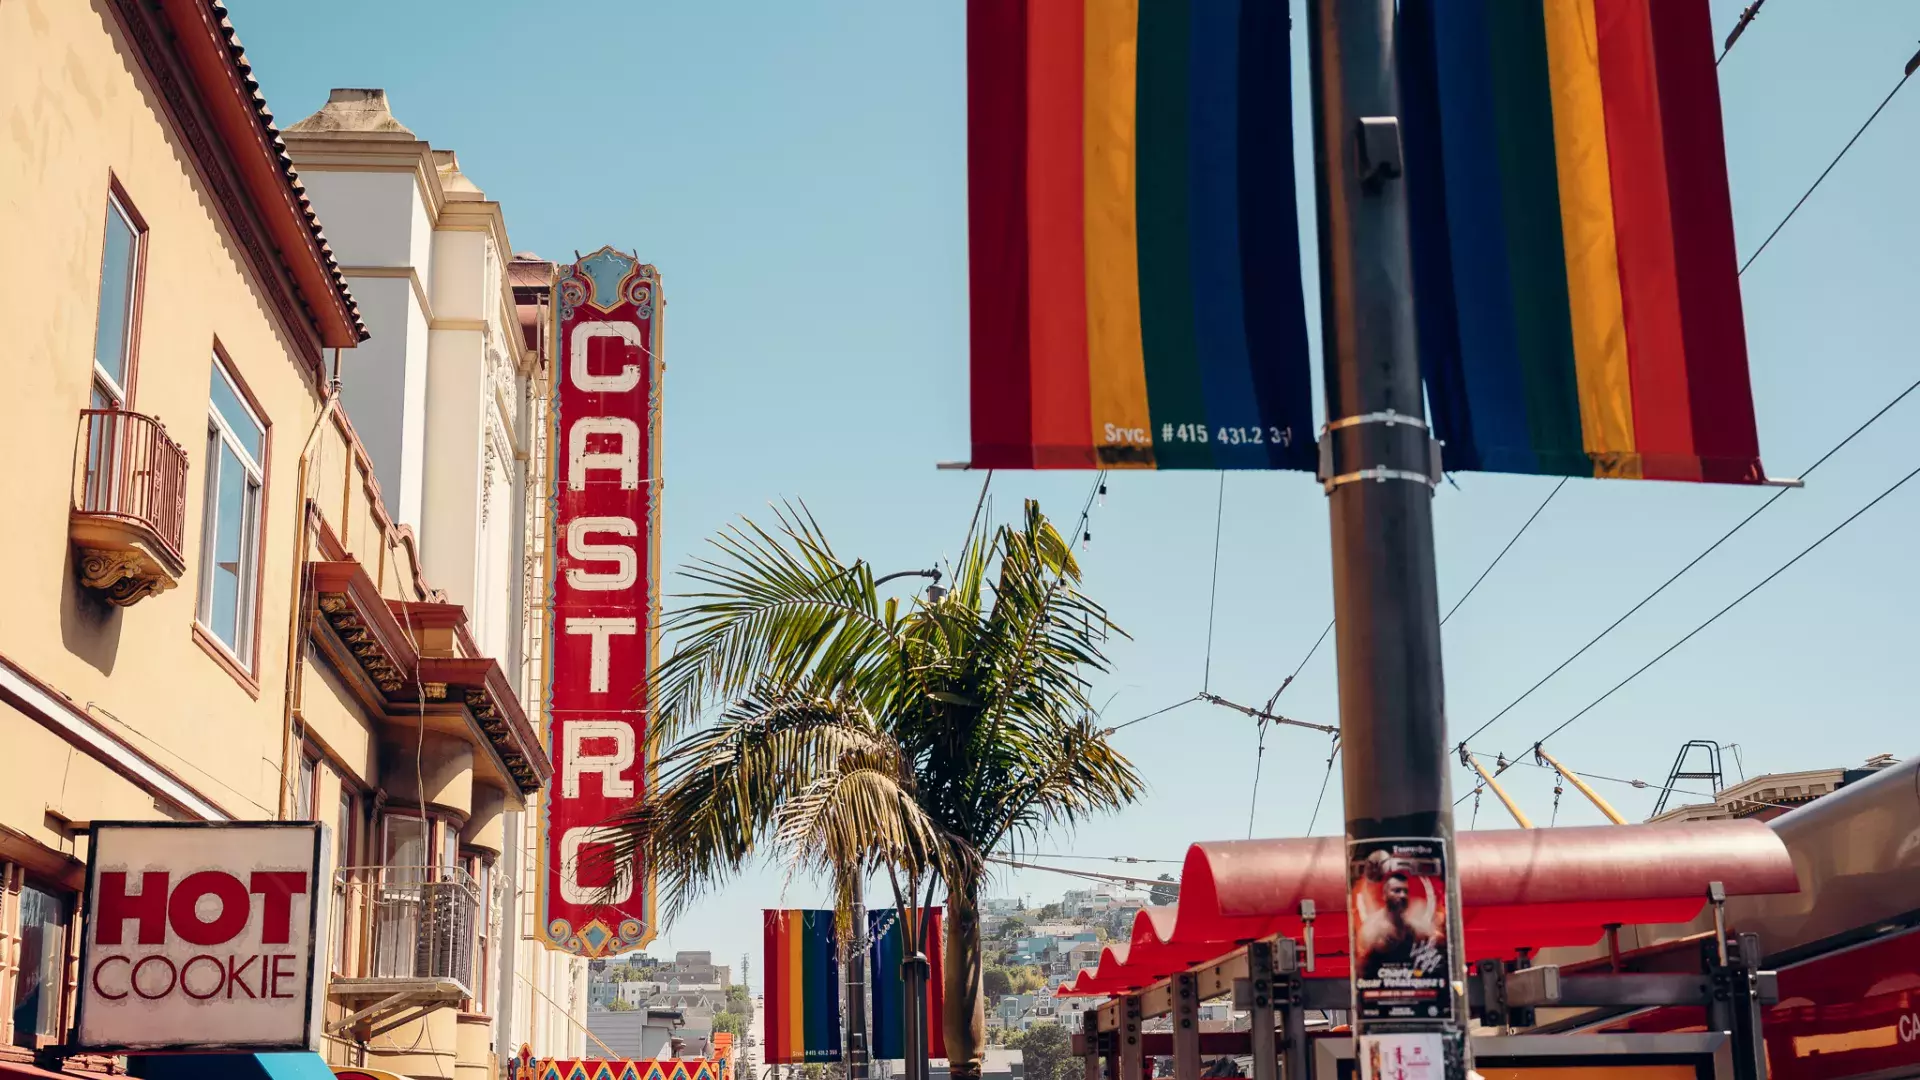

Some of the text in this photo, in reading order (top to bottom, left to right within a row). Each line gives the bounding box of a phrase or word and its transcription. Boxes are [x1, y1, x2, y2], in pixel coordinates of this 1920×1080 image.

[1104, 422, 1151, 443] Srvc.
[1217, 427, 1263, 445] 431.2
[559, 321, 641, 905] CASTRO
[96, 870, 307, 945] HOT
[93, 954, 296, 1000] COOKIE
